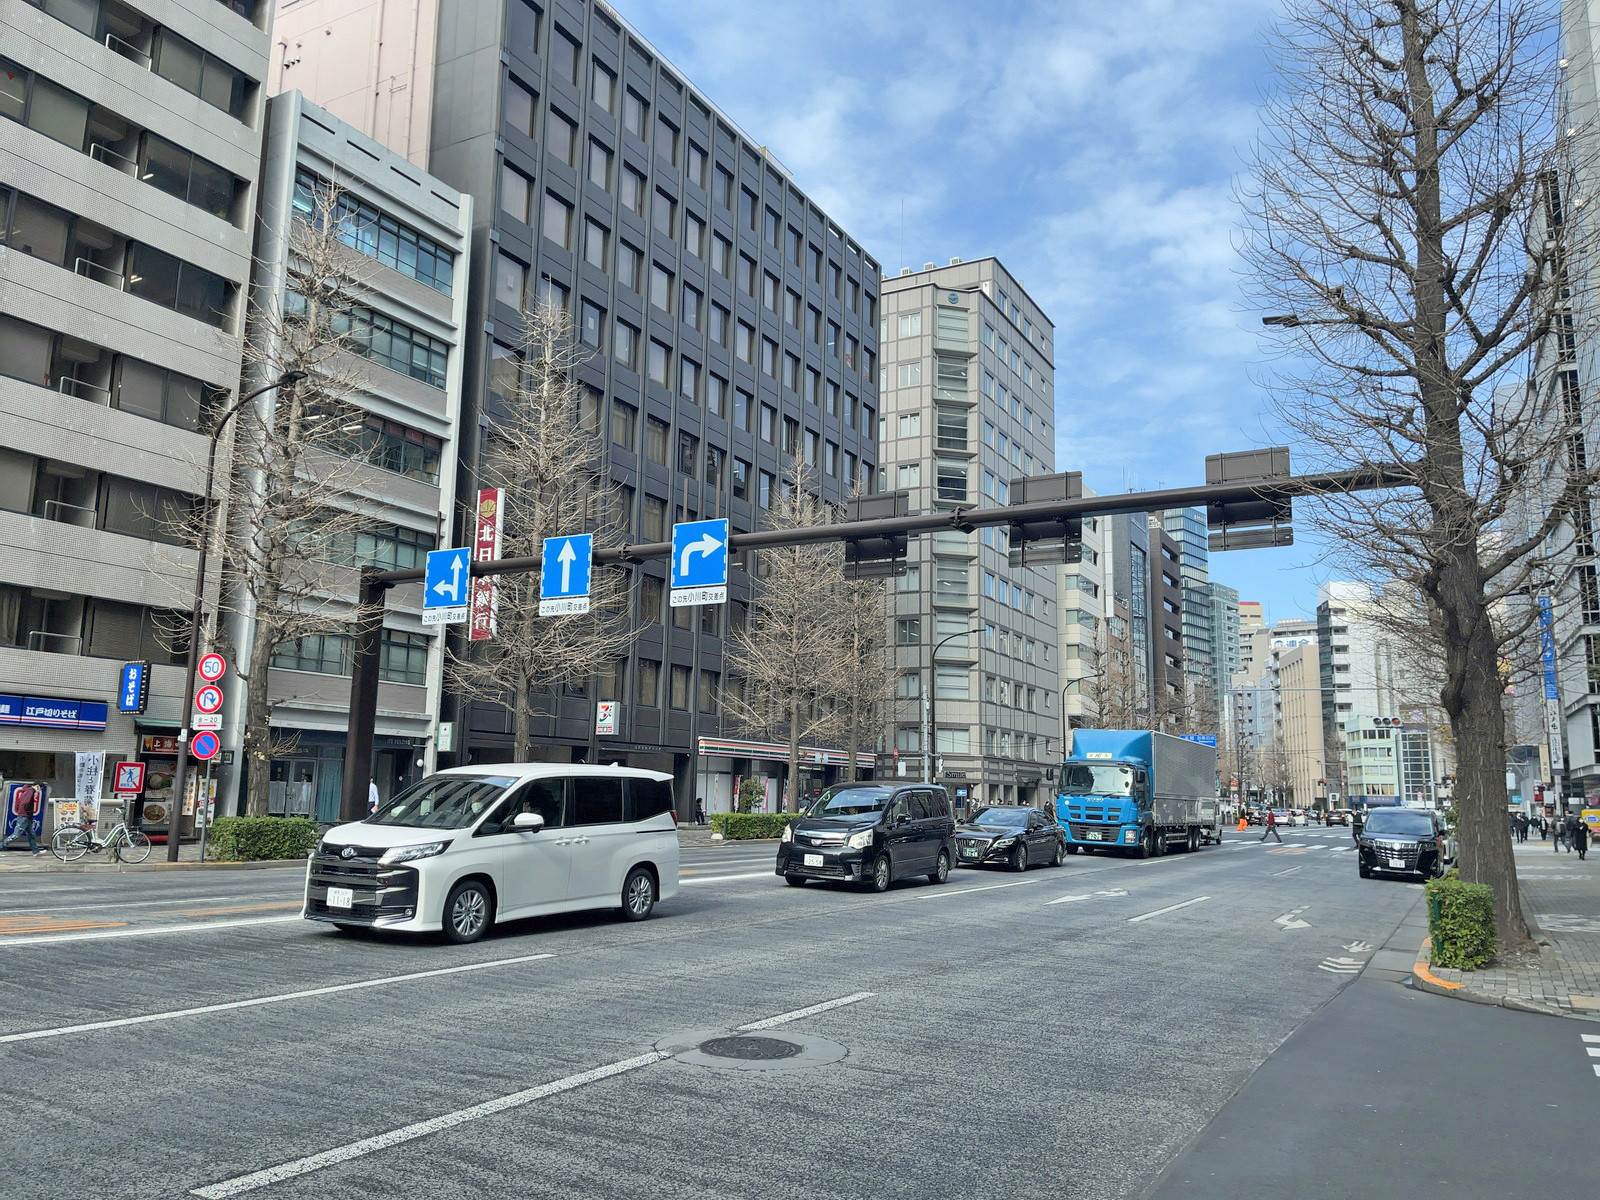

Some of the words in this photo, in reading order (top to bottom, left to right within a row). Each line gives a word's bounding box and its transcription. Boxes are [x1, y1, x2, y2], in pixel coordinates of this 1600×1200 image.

[204, 661, 220, 674] 50
[125, 668, 138, 707] おそば
[25, 706, 78, 719] 江戸切りそば
